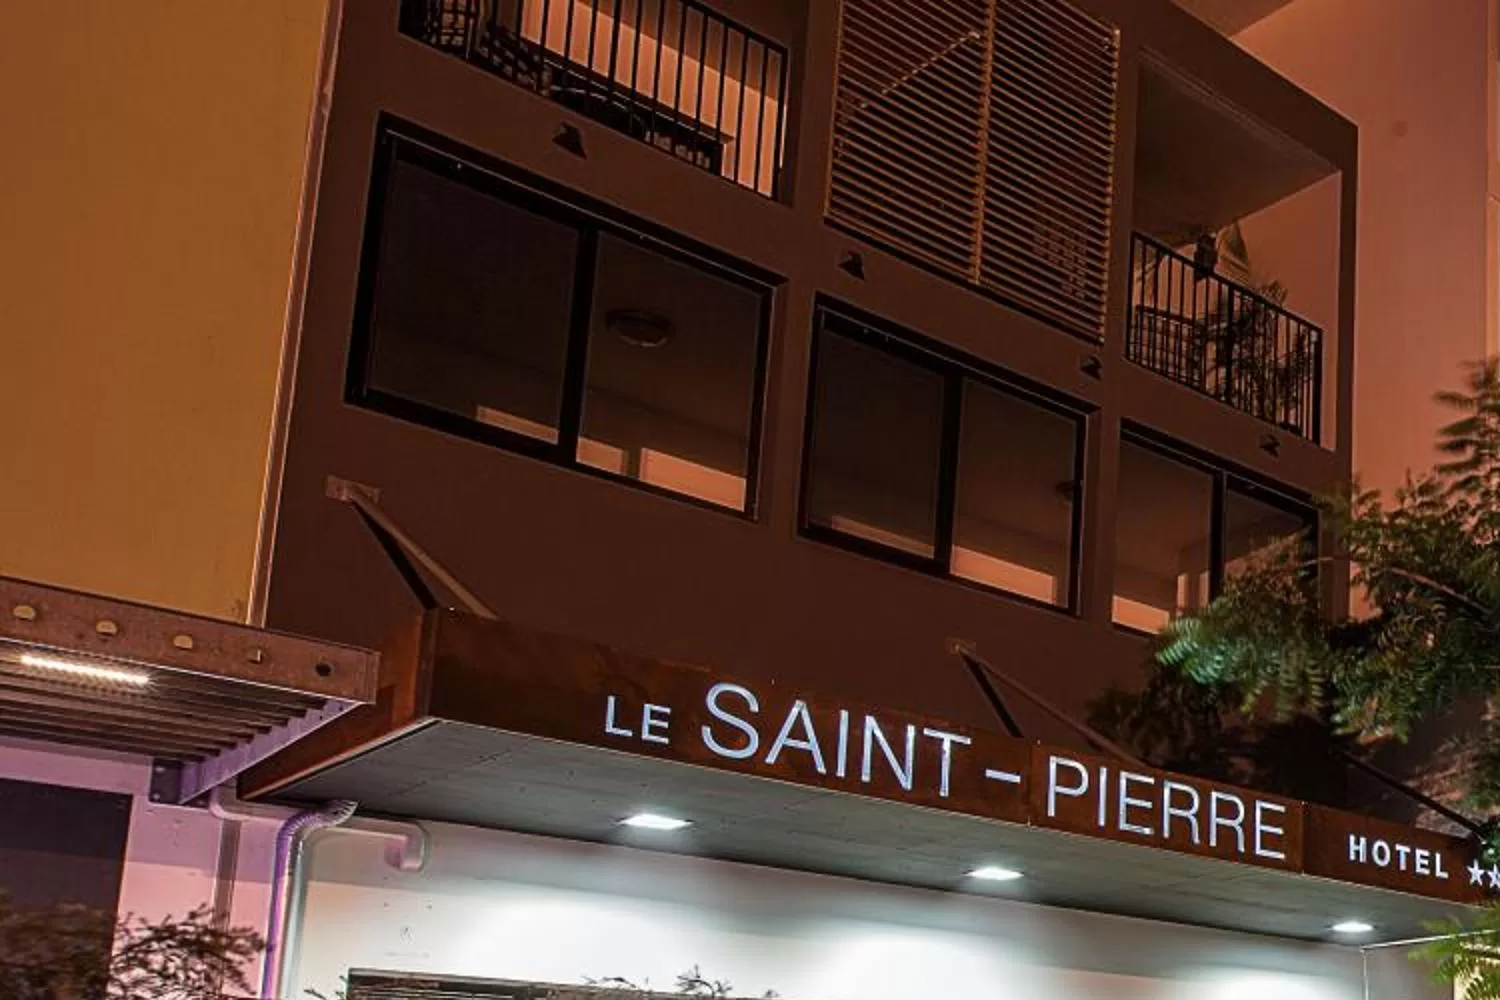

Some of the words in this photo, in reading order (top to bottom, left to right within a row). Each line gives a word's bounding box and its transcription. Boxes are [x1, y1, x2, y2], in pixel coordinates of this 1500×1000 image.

[604, 695, 672, 745] LE
[701, 682, 972, 797] SAINT
[1046, 754, 1288, 860] PIERRE
[1348, 834, 1449, 879] HOTEL
